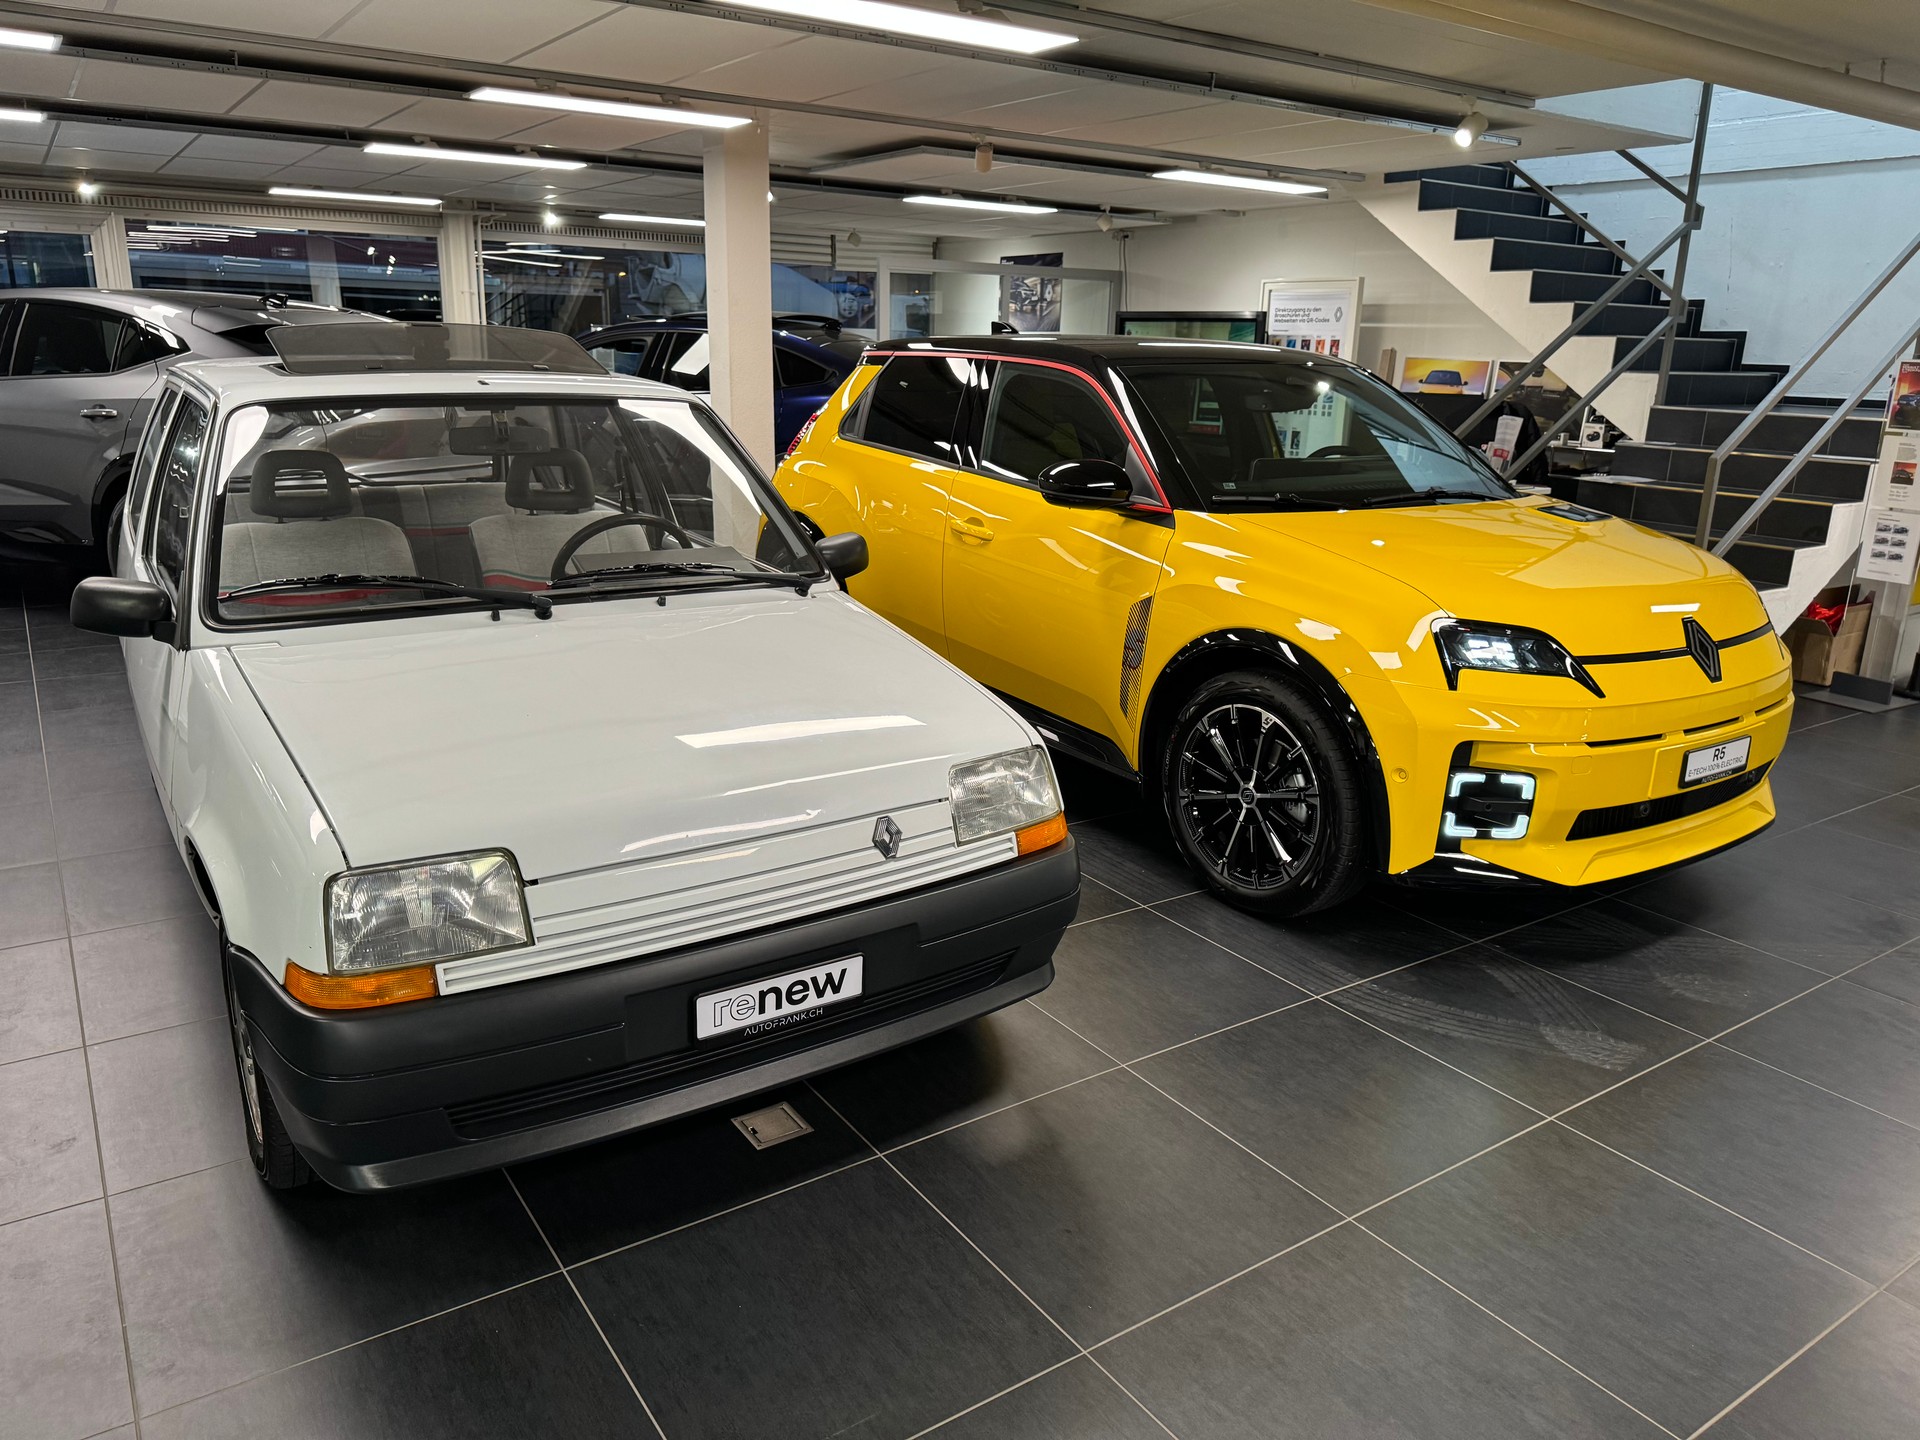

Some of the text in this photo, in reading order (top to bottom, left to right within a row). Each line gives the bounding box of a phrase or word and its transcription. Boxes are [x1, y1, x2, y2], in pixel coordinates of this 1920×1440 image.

[1712, 746, 1726, 761] R5
[1688, 756, 1743, 777] E-TECH 100% ELECTRIC
[714, 968, 847, 1028] renew
[744, 1007, 823, 1036] AUTOFRANK.CH
